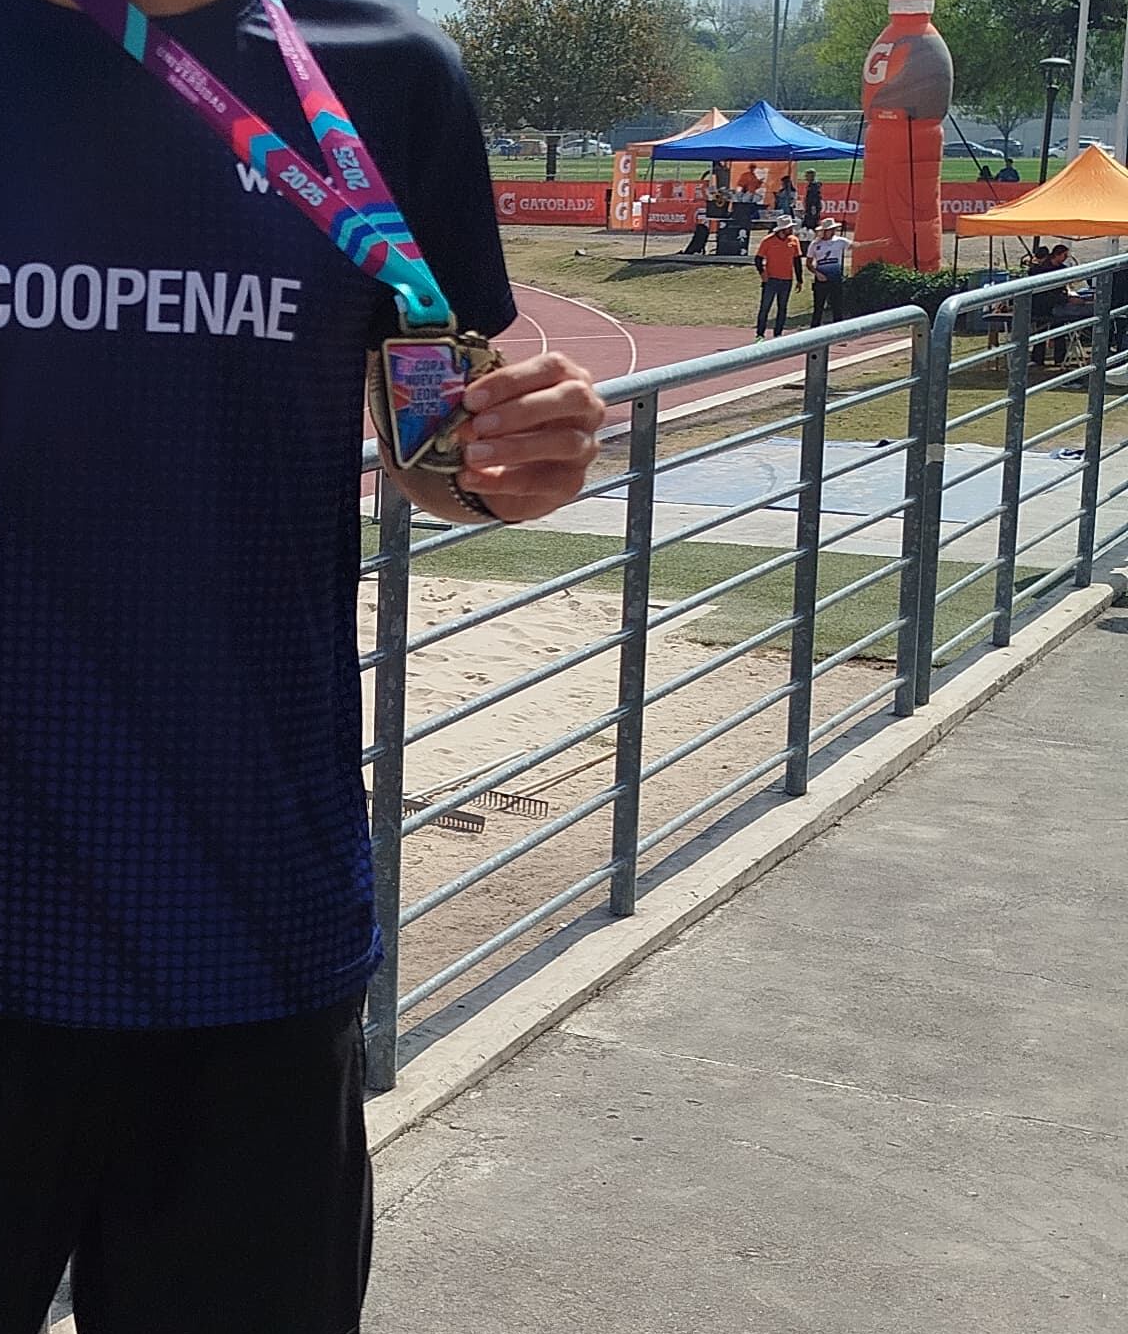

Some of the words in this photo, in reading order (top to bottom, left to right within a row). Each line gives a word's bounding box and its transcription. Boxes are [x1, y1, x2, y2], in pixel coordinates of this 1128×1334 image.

[279, 164, 328, 207] 2025
[333, 146, 370, 191] 2025
[519, 198, 595, 211] GATORADE
